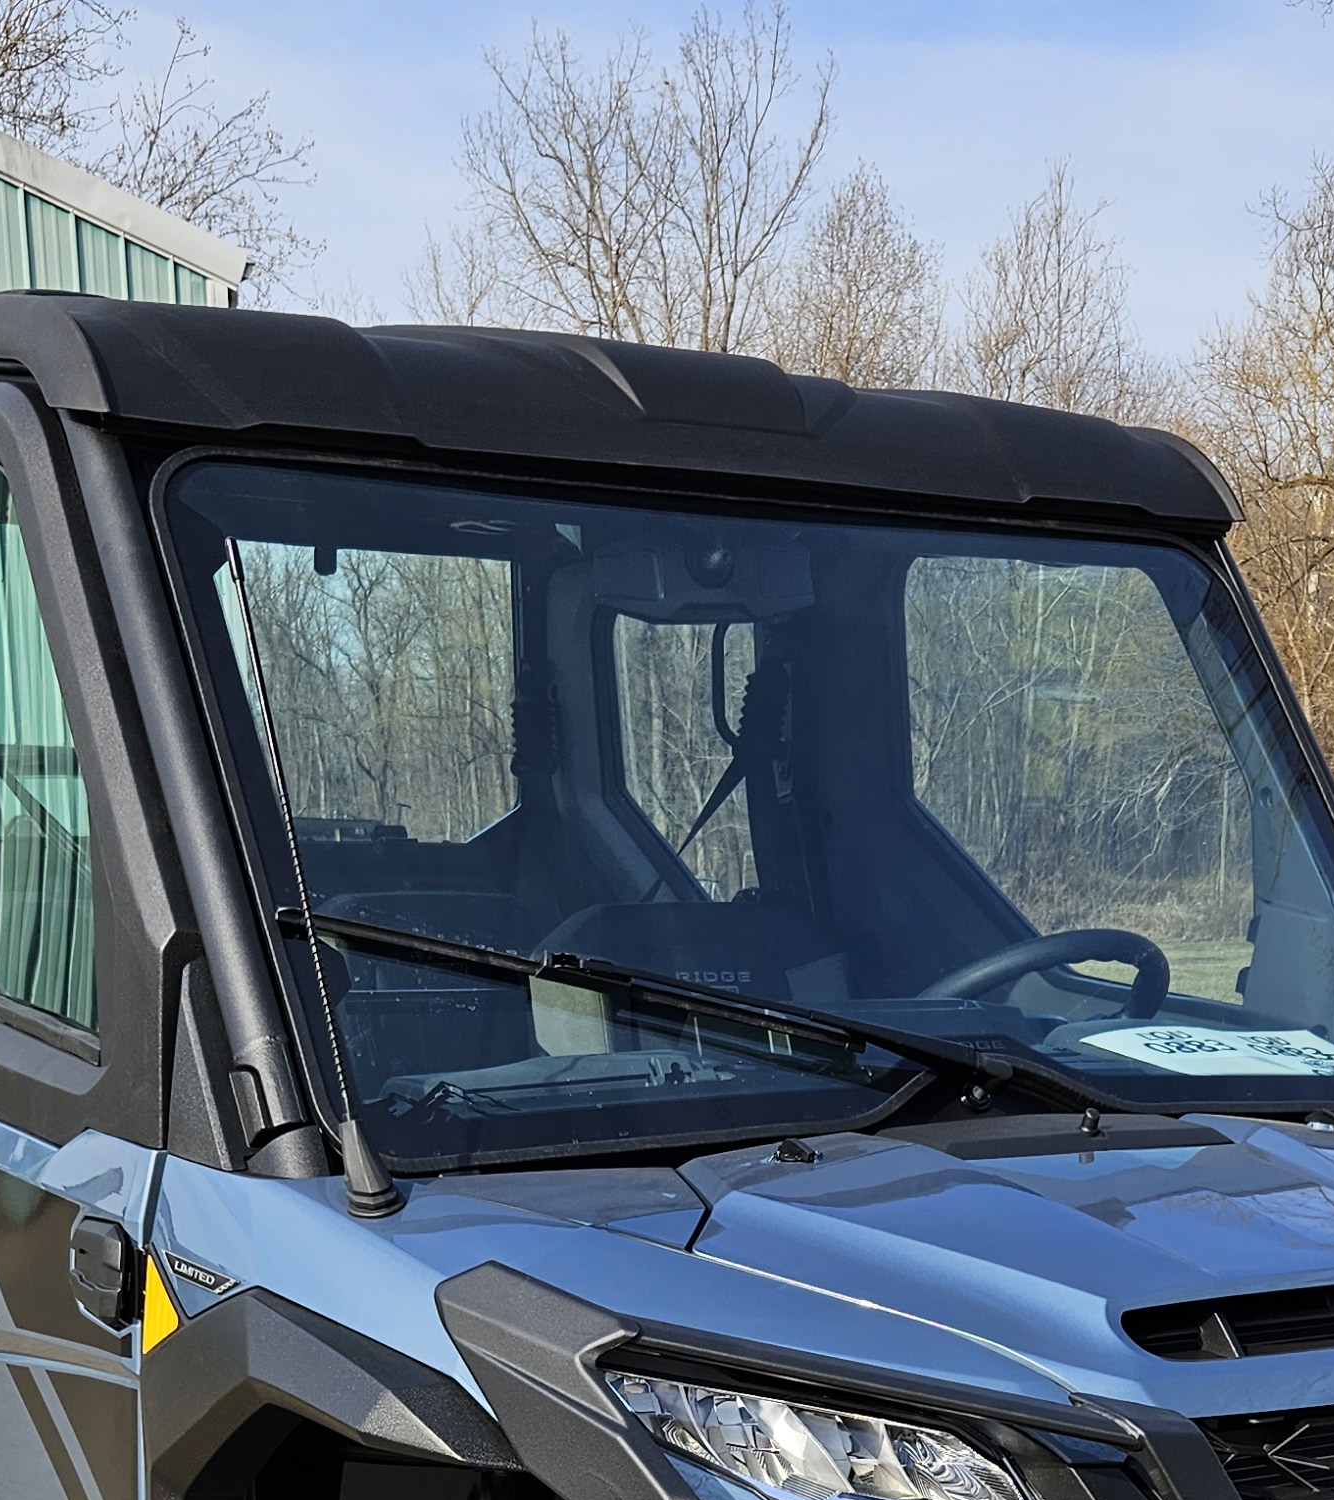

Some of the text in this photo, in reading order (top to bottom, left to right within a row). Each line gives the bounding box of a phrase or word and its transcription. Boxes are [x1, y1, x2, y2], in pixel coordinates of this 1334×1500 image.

[675, 971, 751, 983] RIDGE
[1135, 1030, 1193, 1041] LOU
[1143, 1039, 1238, 1054] 0883
[174, 1260, 216, 1286] LIMITED
